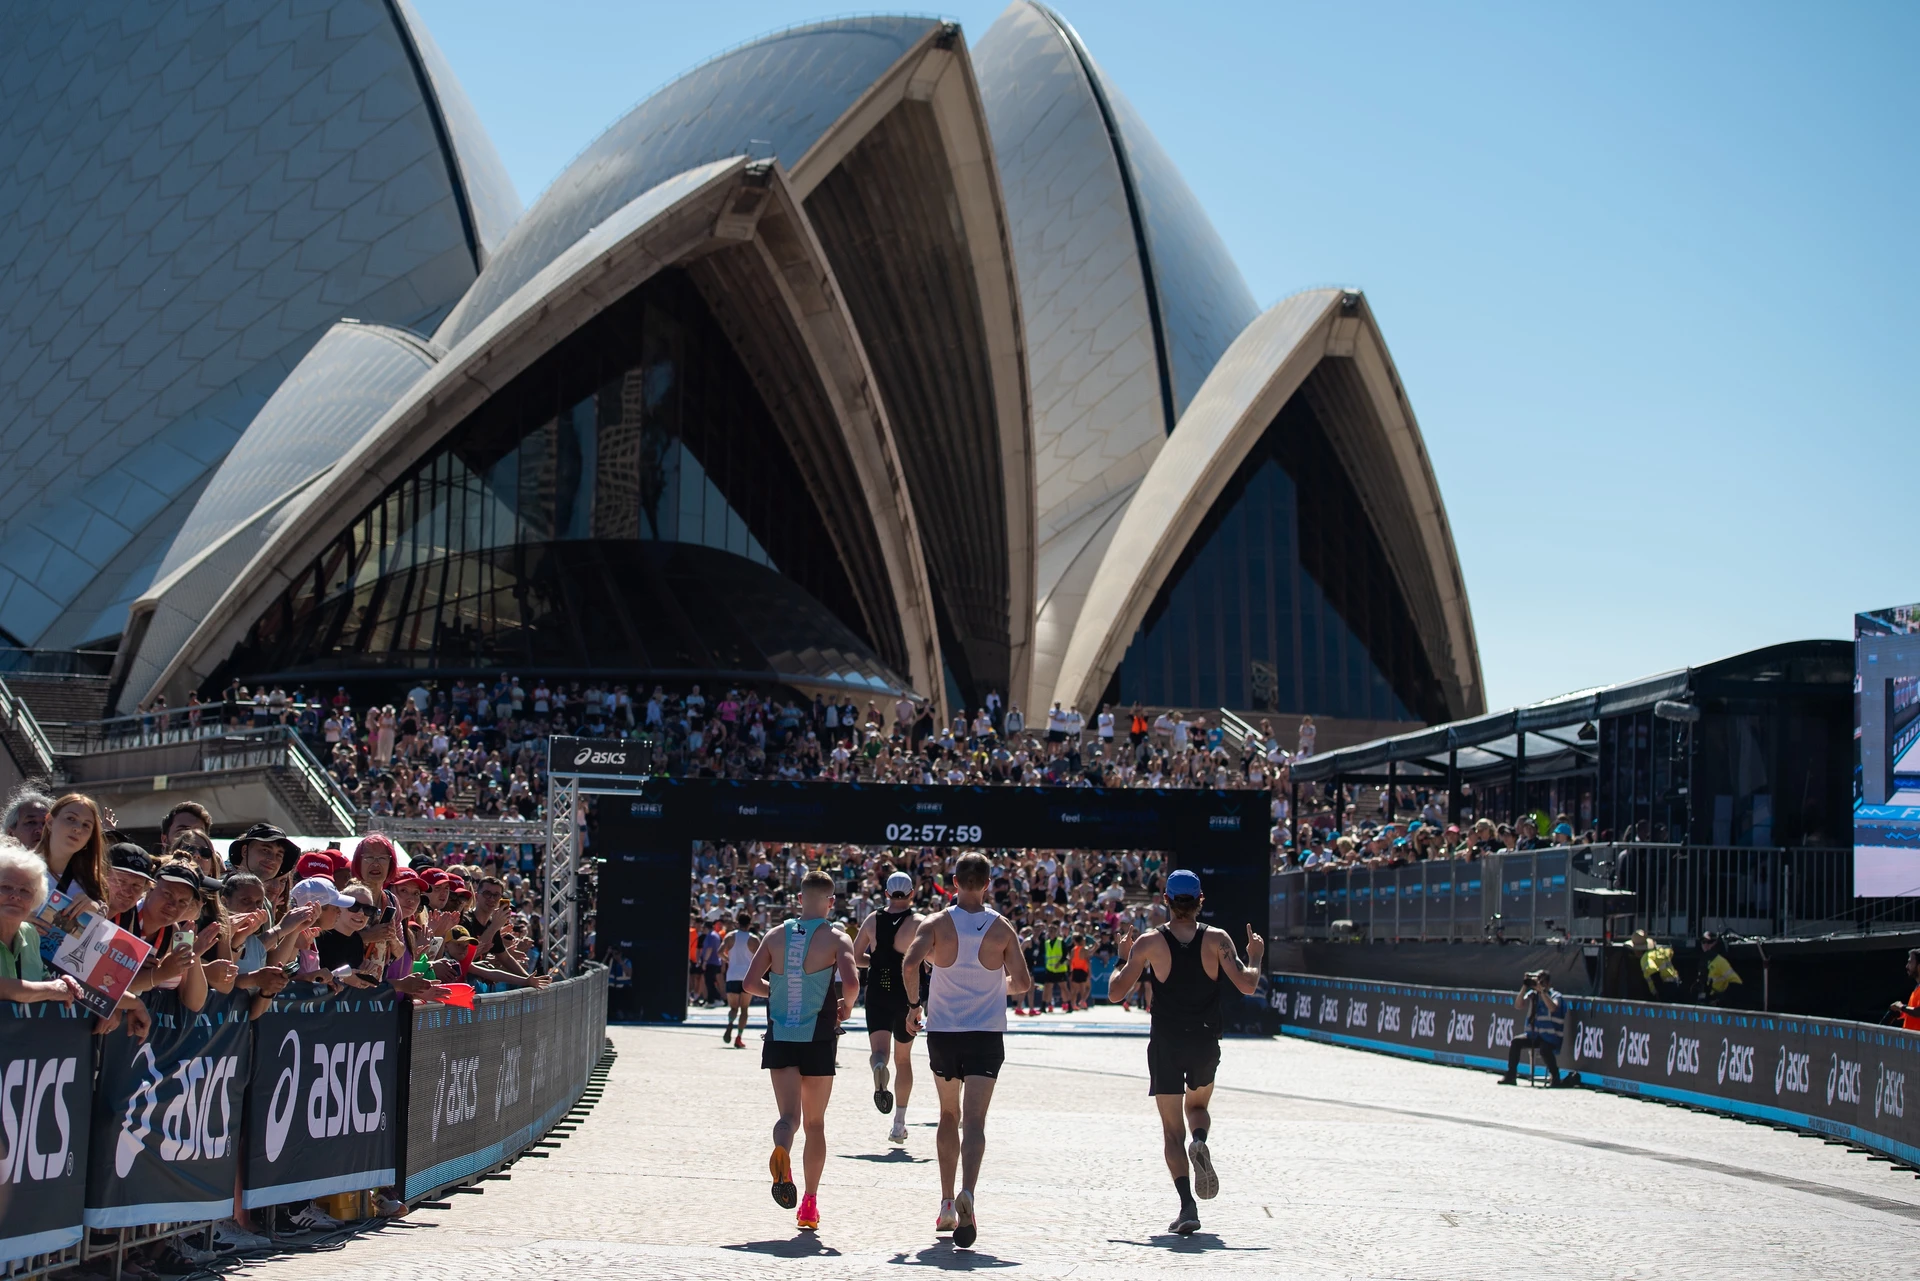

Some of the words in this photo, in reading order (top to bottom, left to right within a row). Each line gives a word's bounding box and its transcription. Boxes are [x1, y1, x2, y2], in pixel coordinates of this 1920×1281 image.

[739, 805, 757, 815] feel
[1061, 813, 1080, 822] feel
[886, 823, 982, 842] 02:57:59
[94, 941, 107, 954] GO
[109, 947, 139, 971] TEAM!
[84, 991, 107, 1009] LLEZ
[307, 1041, 385, 1139] asics
[0, 1057, 77, 1186] SICS
